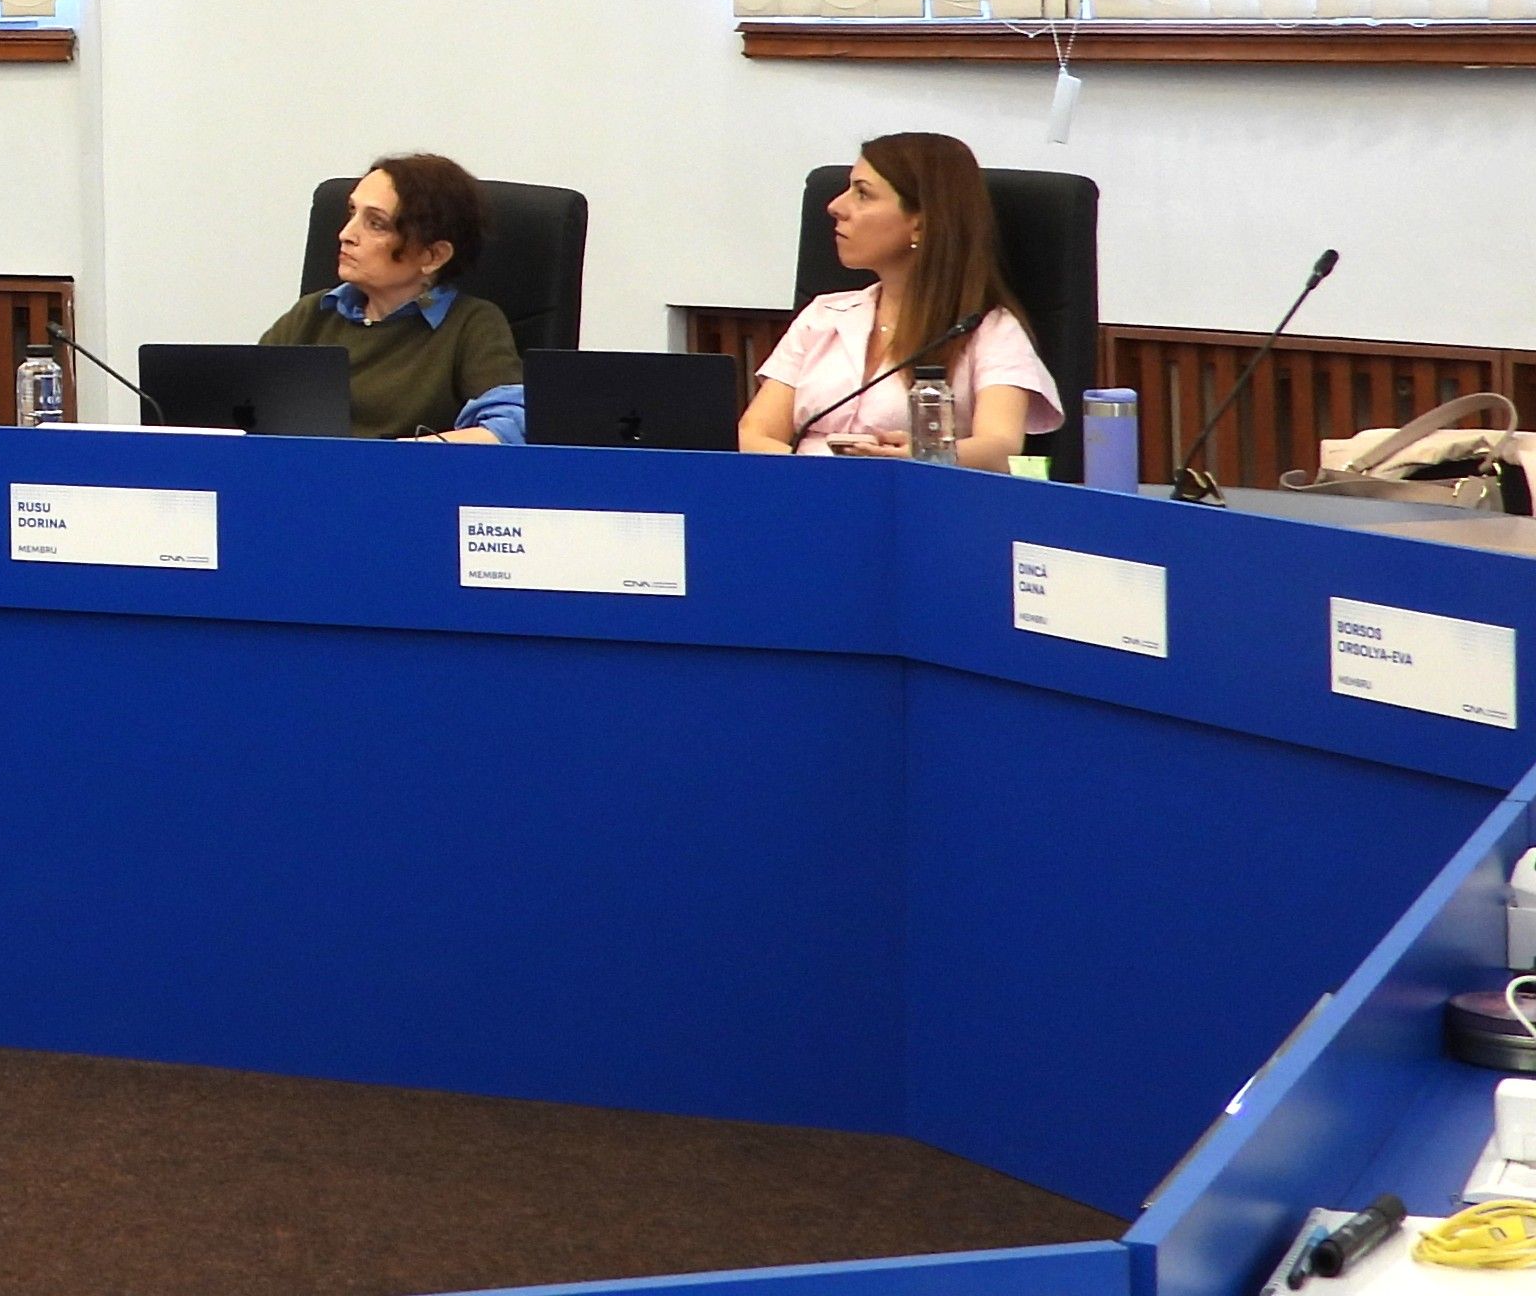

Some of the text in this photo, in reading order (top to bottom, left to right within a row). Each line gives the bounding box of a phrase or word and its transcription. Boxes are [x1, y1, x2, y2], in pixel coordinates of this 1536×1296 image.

[17, 501, 51, 513] RUSU
[18, 517, 67, 529] DORINA
[468, 523, 523, 537] BÂRSAN
[18, 545, 58, 555] MEMBRU
[468, 541, 526, 554] DANIELA
[468, 570, 512, 581] MEMBRU
[1337, 619, 1383, 641] BORSOS
[1337, 640, 1413, 665] ORSOLYA-EVA
